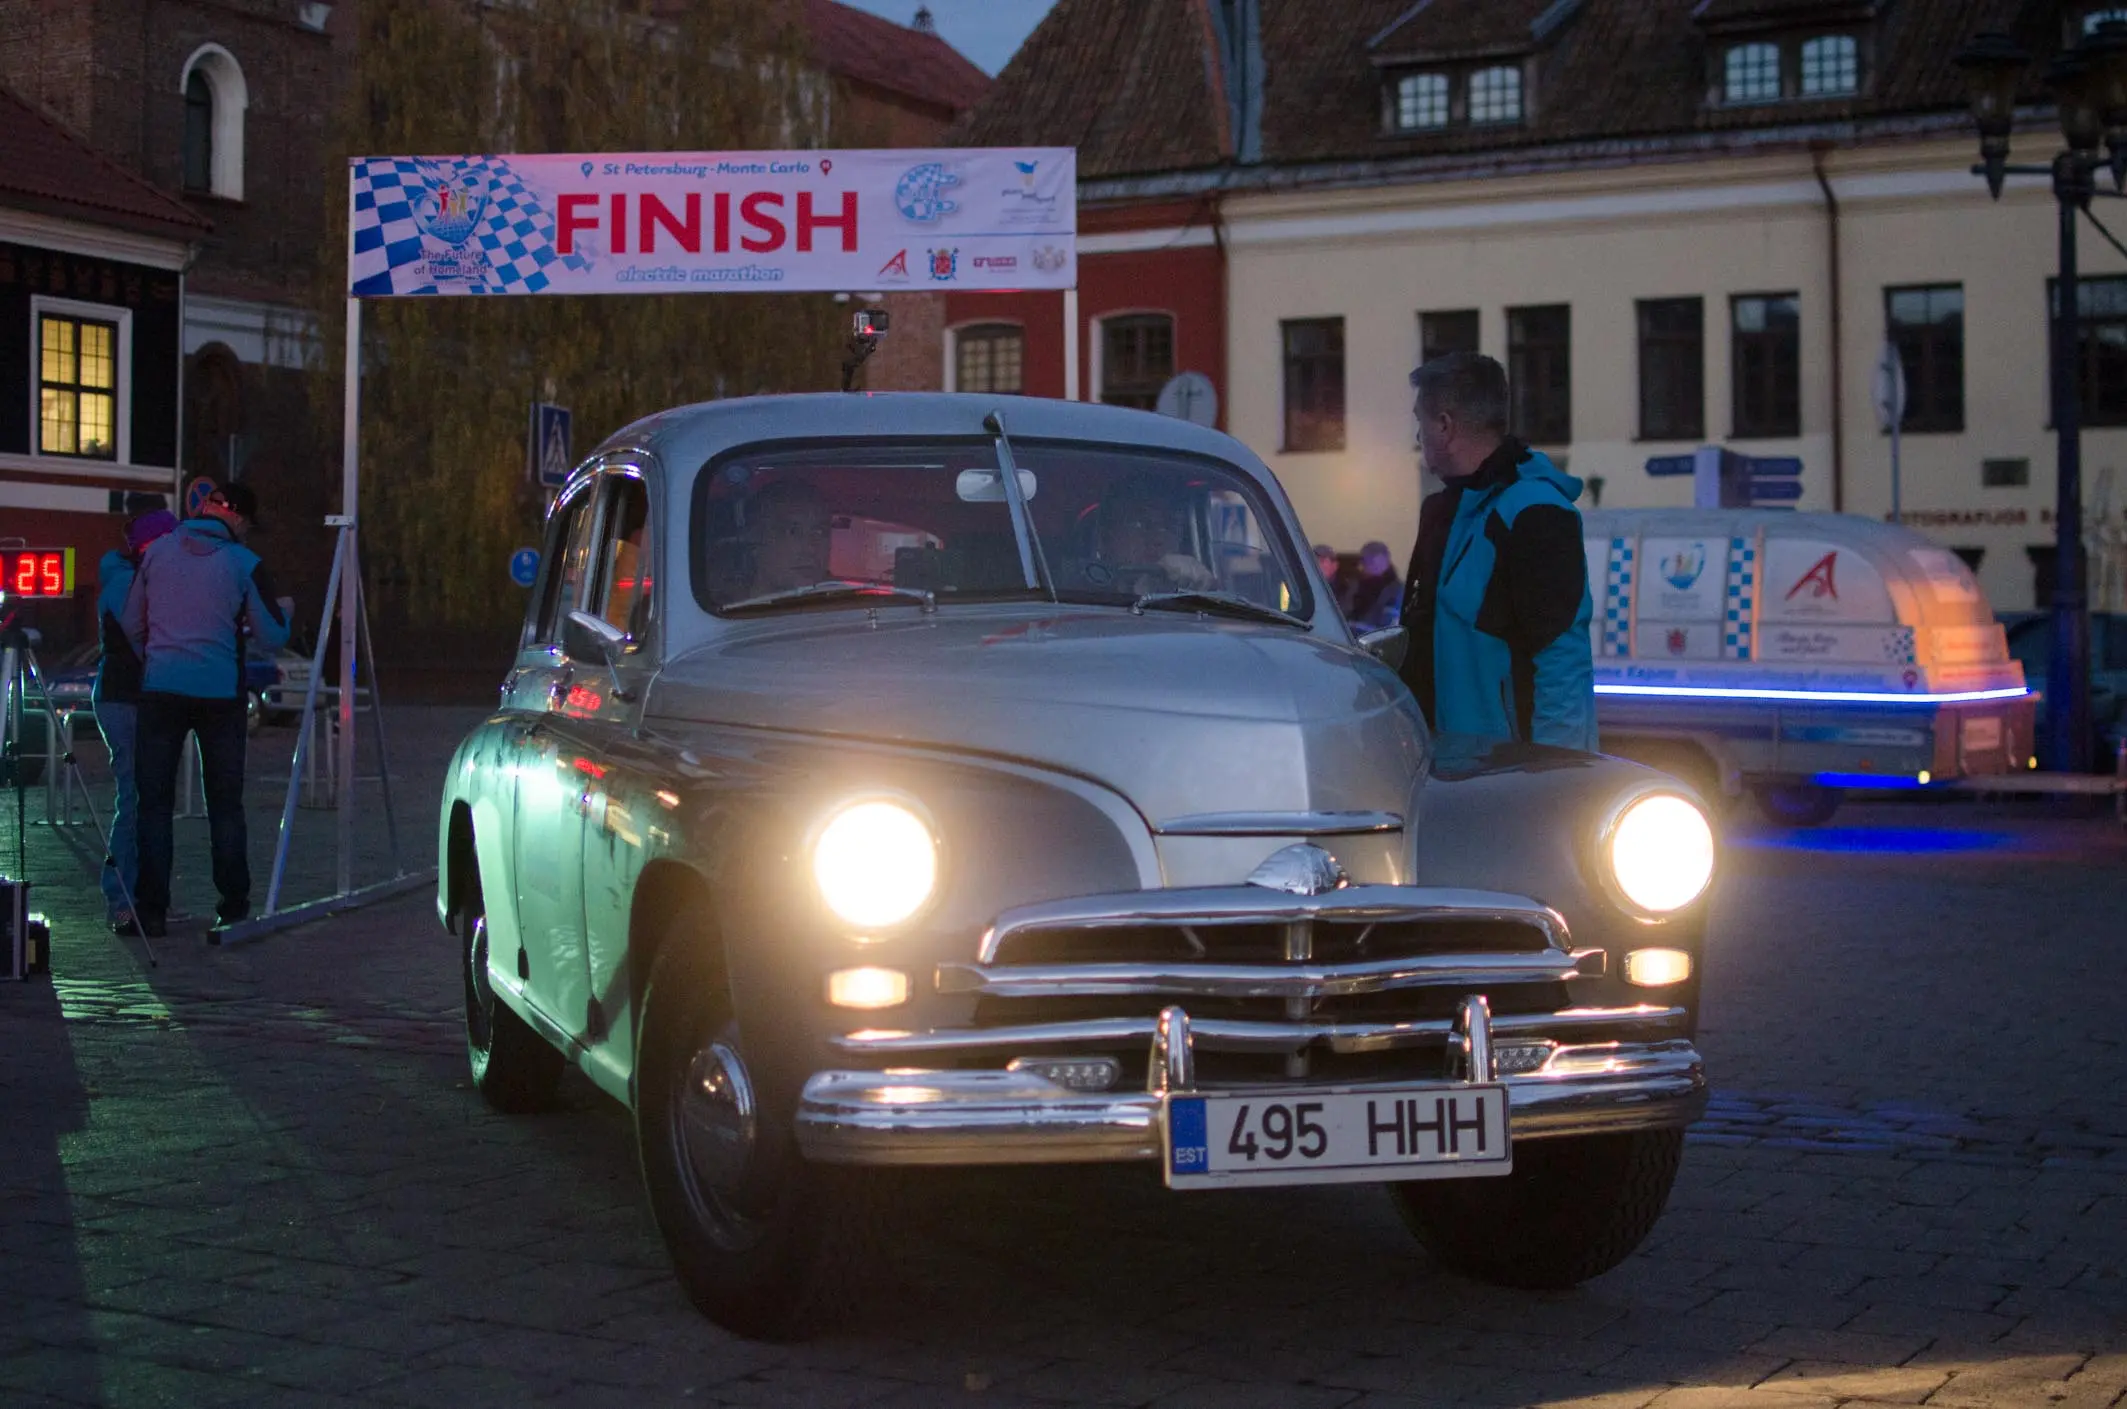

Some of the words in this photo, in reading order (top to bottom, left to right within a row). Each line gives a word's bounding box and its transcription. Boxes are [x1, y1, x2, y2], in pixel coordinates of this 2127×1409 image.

[603, 164, 620, 175] St
[770, 162, 811, 174] Carlo
[556, 192, 858, 255] FINISH
[414, 266, 425, 275] of
[429, 264, 488, 275] Homeland
[616, 266, 687, 282] electric
[690, 264, 784, 281] marathon
[17, 559, 60, 591] 25
[1228, 1103, 1328, 1161] 495
[1367, 1097, 1486, 1156] HHH
[1174, 1147, 1206, 1164] EST
